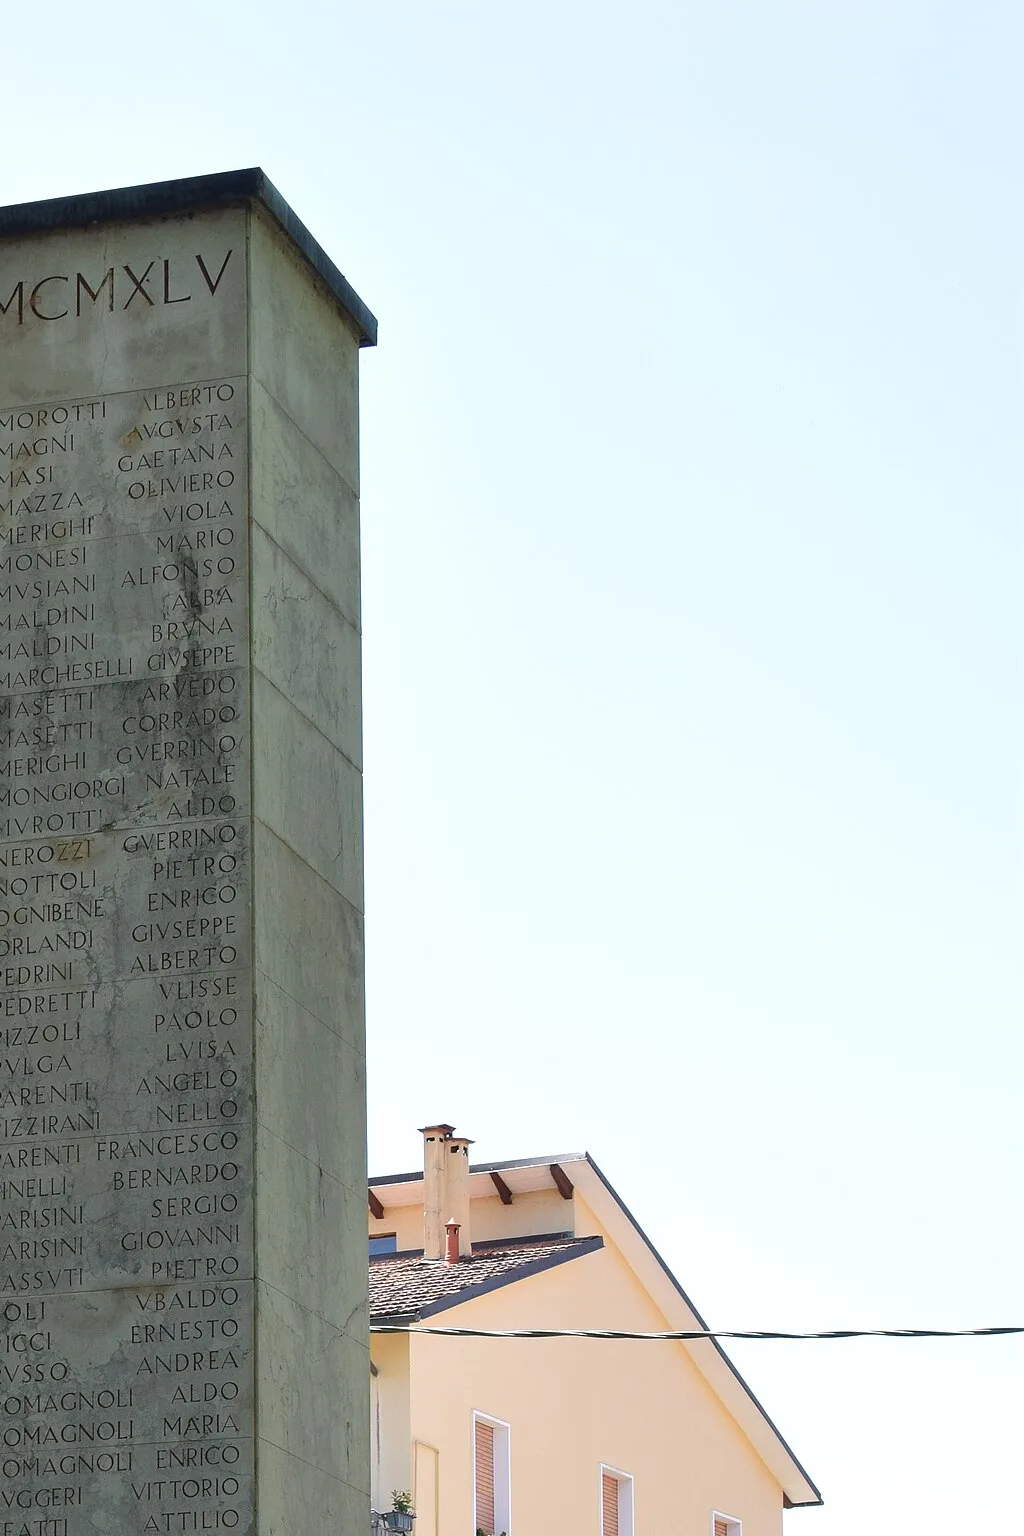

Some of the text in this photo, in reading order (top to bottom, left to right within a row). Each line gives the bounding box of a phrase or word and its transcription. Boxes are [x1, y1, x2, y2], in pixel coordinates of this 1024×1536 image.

[117, 437, 233, 477] GAETANA
[127, 466, 235, 504] OLIVIERO
[156, 525, 234, 557] MARIO
[146, 763, 235, 794] NATALE
[154, 853, 236, 883] PIETRO
[148, 882, 236, 914] ENRICO
[131, 912, 235, 946] GIVSEPPE
[130, 943, 236, 976] ALBERTO
[154, 1005, 237, 1034] PAOLO
[136, 1066, 237, 1098] ANGELO
[112, 1159, 239, 1193] BERNARDO
[152, 1191, 238, 1220] SERGIO
[171, 1380, 239, 1405] ALDO
[156, 1443, 239, 1470] ENRICO
[130, 1474, 239, 1503] VITTORIO
